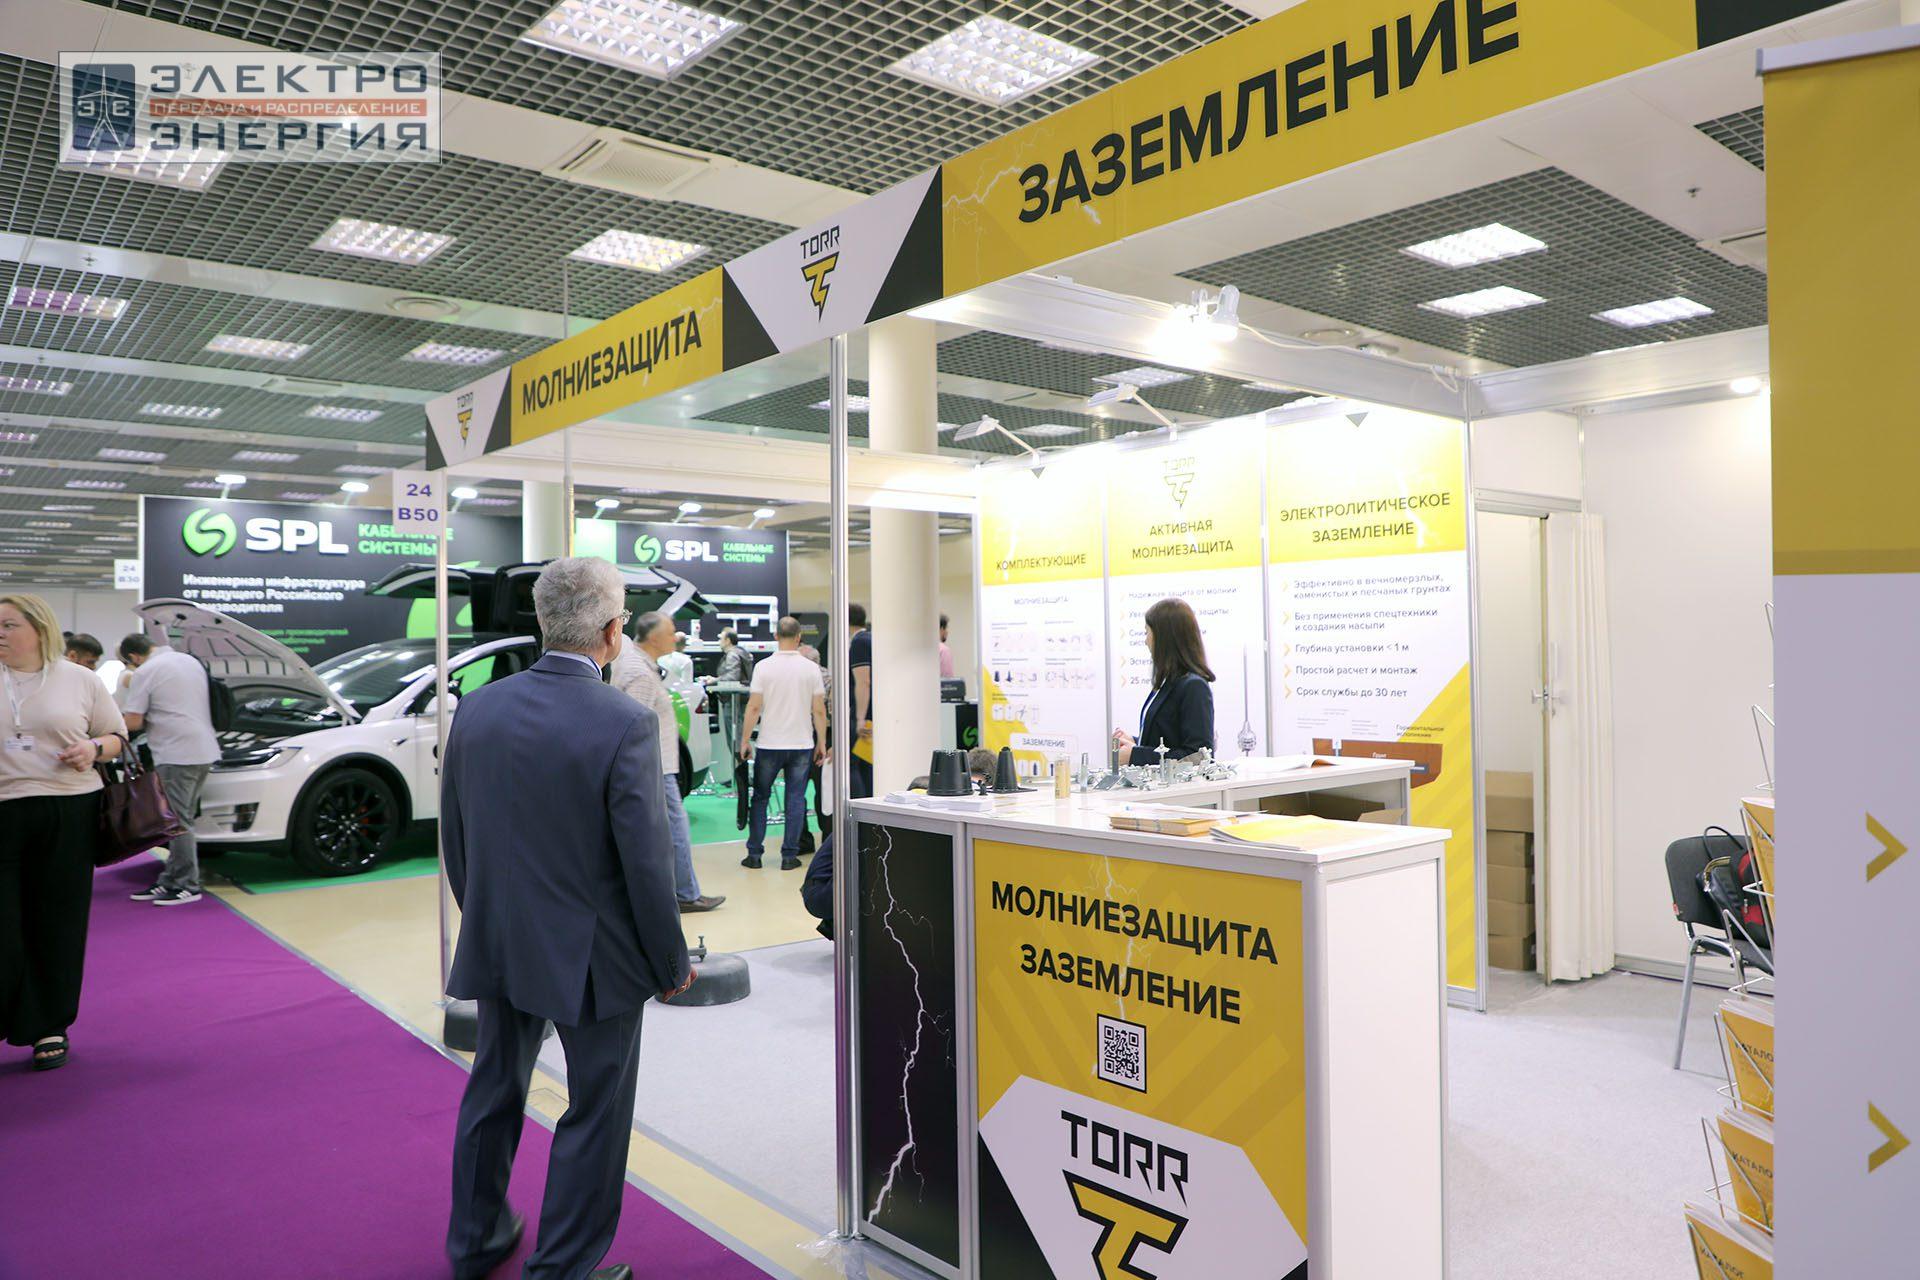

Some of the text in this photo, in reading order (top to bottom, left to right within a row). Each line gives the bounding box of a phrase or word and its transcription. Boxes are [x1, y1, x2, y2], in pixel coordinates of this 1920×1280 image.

[1018, 0, 1519, 223] ЗАЗЕМЛЕНИЕ
[800, 225, 840, 259] TORR
[523, 311, 701, 415] МОЛНИЕЗАЩИТА
[406, 483, 432, 497] 24
[397, 507, 439, 521] B50
[1280, 492, 1450, 522] ЭЛЕКТРОЛИТИЧЕСКОЕ
[245, 517, 349, 554] SPL
[1149, 519, 1213, 536] АКТИВНАЯ
[1312, 522, 1414, 543] ЗАЗЕМЛЕНИЕ
[358, 540, 438, 556] СИСТЕМЫ
[665, 539, 718, 562] SPL
[722, 542, 775, 554] КАБЕЛЬНЫЕ
[1132, 539, 1234, 559] МОЛНИЕЗАЩИТА
[722, 553, 766, 564] СИСТЕМЫ
[996, 553, 1087, 570] КОМПЛЕКТУЮЩИЕ
[182, 573, 366, 591] Инженерная инфраструктура
[1294, 579, 1354, 589] Эффективно
[182, 588, 345, 602] от ведущего Российского
[1294, 590, 1349, 599] каменистых
[1360, 587, 1409, 597] песчаных
[1411, 584, 1452, 596] грунтах
[1294, 609, 1438, 621] Без применения спецтехники
[1302, 623, 1346, 632] создания
[1348, 623, 1385, 632] насыпи
[1295, 644, 1333, 655] Глубина
[1335, 645, 1385, 654] установки
[1295, 665, 1335, 676] Простой
[1336, 667, 1369, 676] расчет
[1379, 667, 1418, 675] монтаж
[1130, 675, 1140, 685] 25
[1296, 686, 1408, 698] Срок службы до 30 лет
[991, 880, 1279, 966] МОЛНИЕЗАЩИТА
[1019, 944, 1242, 1025] ЗАЗЕМЛЕНИЕ
[1060, 1109, 1189, 1208] TORR
